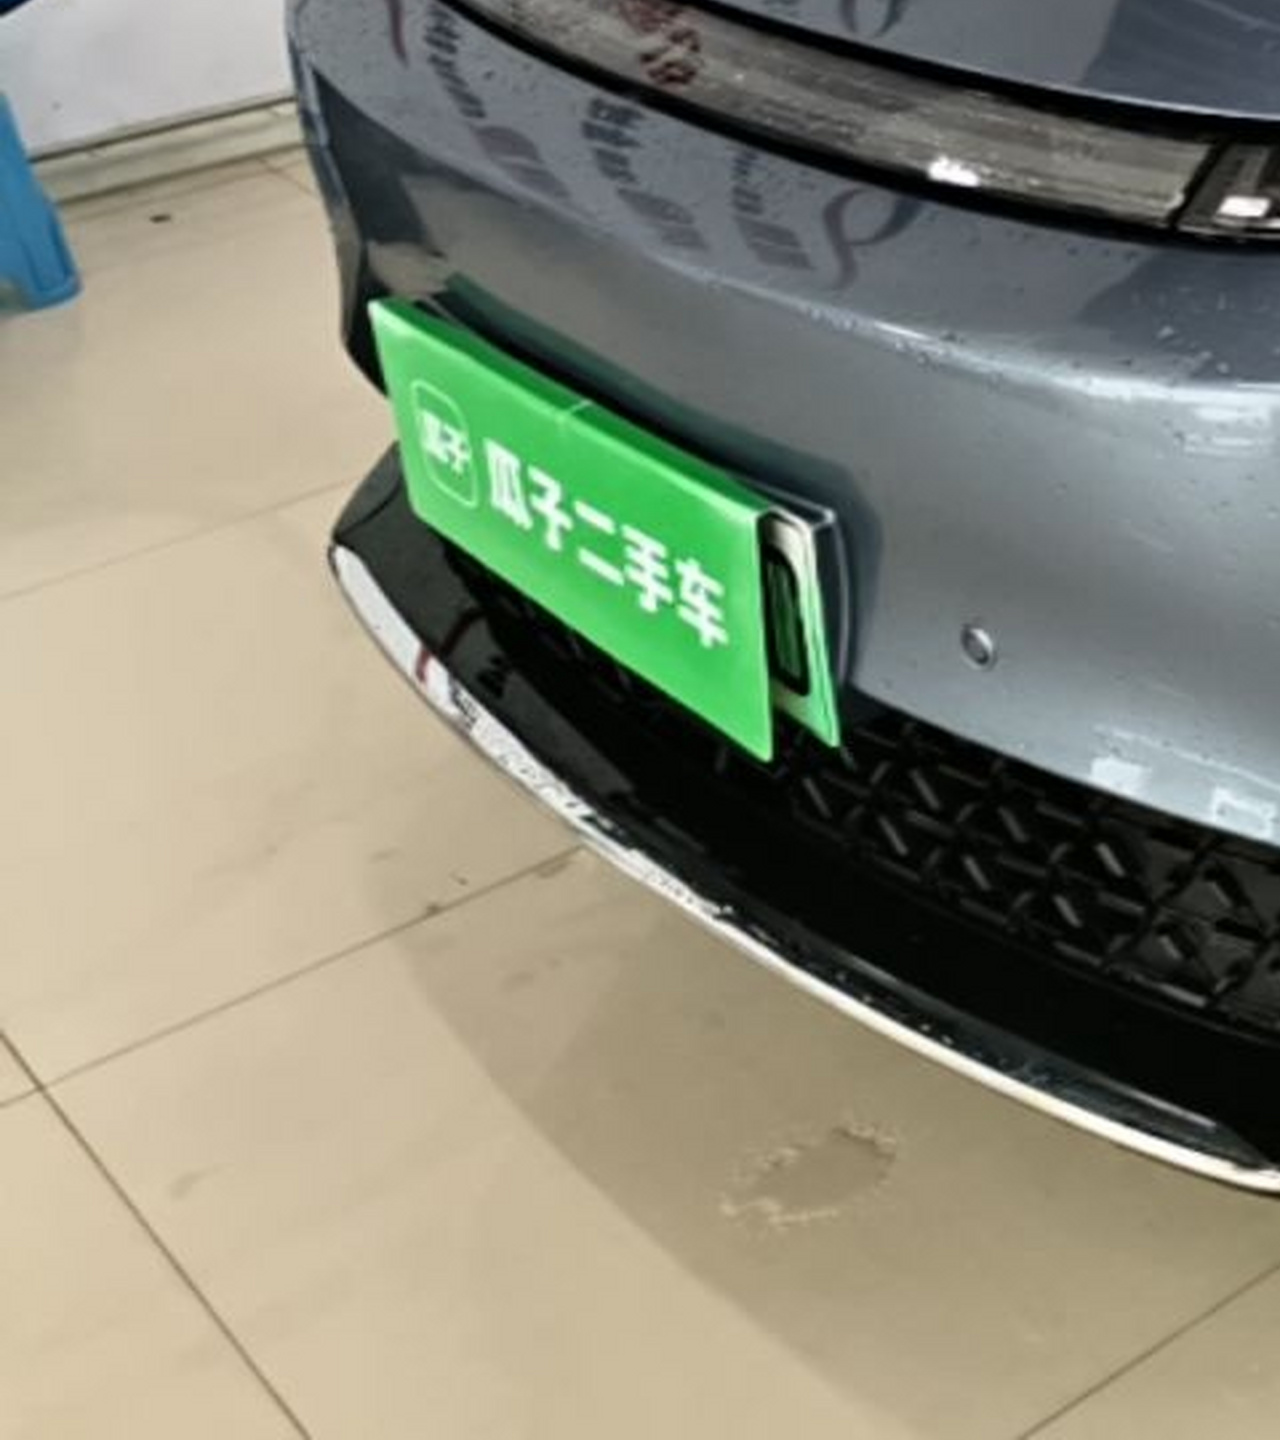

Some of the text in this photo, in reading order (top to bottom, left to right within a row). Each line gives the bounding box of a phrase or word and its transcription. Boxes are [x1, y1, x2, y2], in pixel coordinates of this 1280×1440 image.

[485, 438, 728, 648] 瓜子二手车
